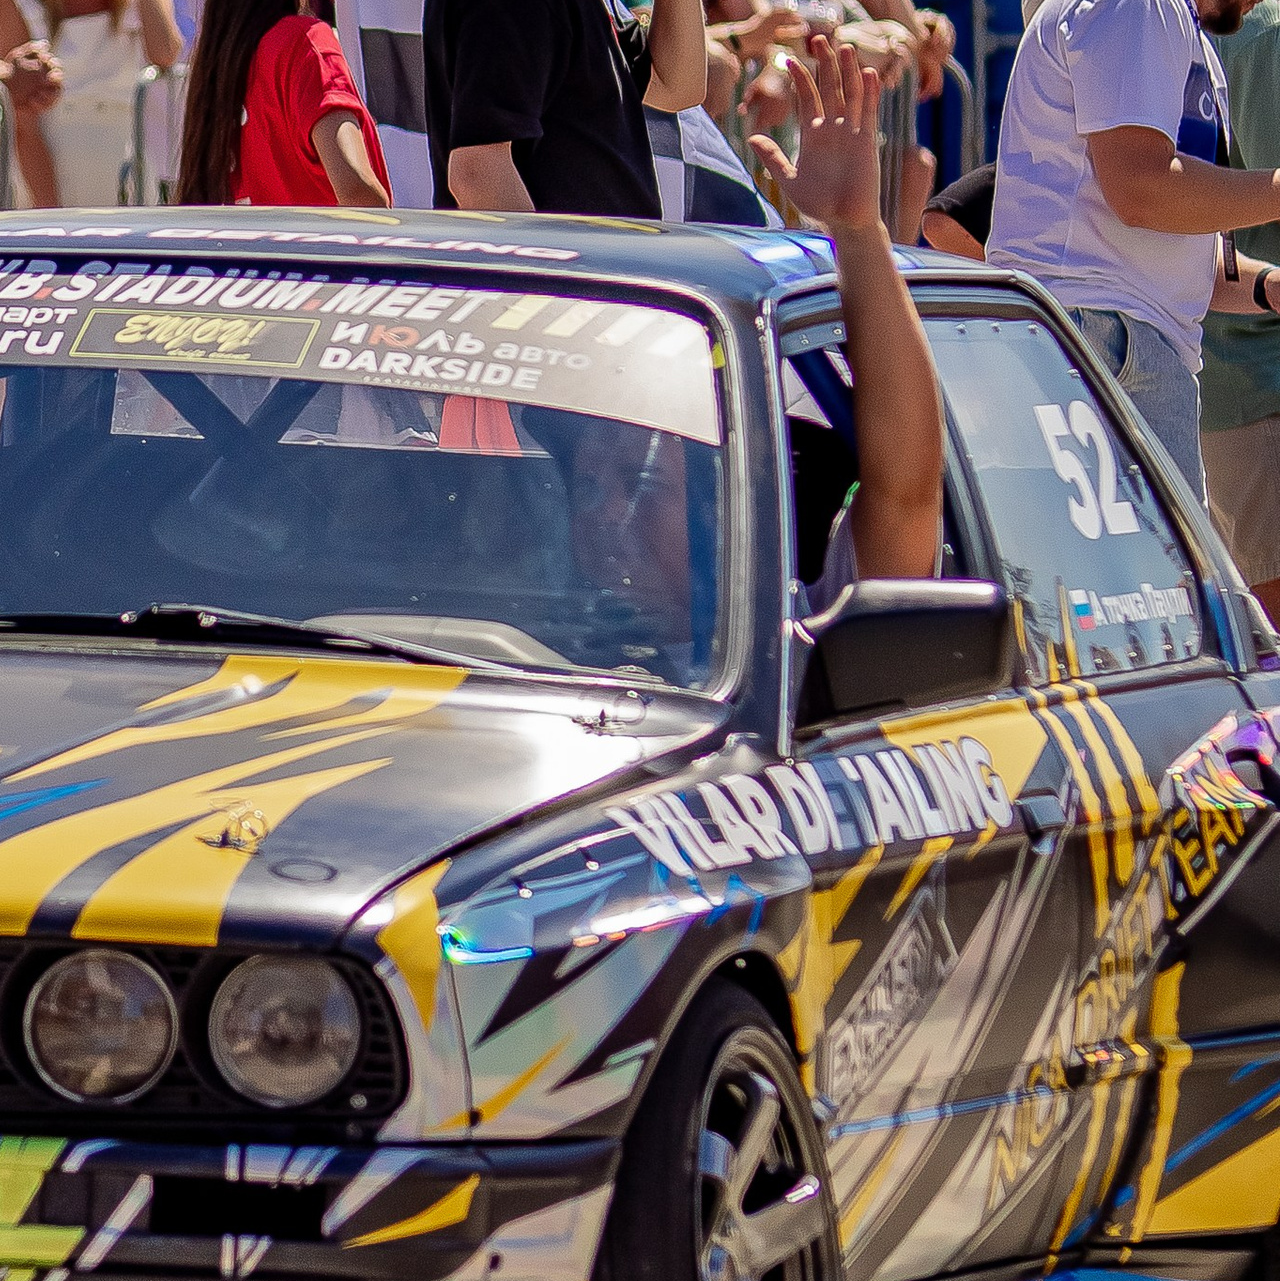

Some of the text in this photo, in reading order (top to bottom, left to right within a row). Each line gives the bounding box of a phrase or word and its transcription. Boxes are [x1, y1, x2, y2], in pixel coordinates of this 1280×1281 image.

[146, 226, 582, 261] DETAILING
[318, 345, 543, 391] DARKSIDE
[1033, 399, 1141, 540] 52
[605, 773, 799, 878] VILAR
